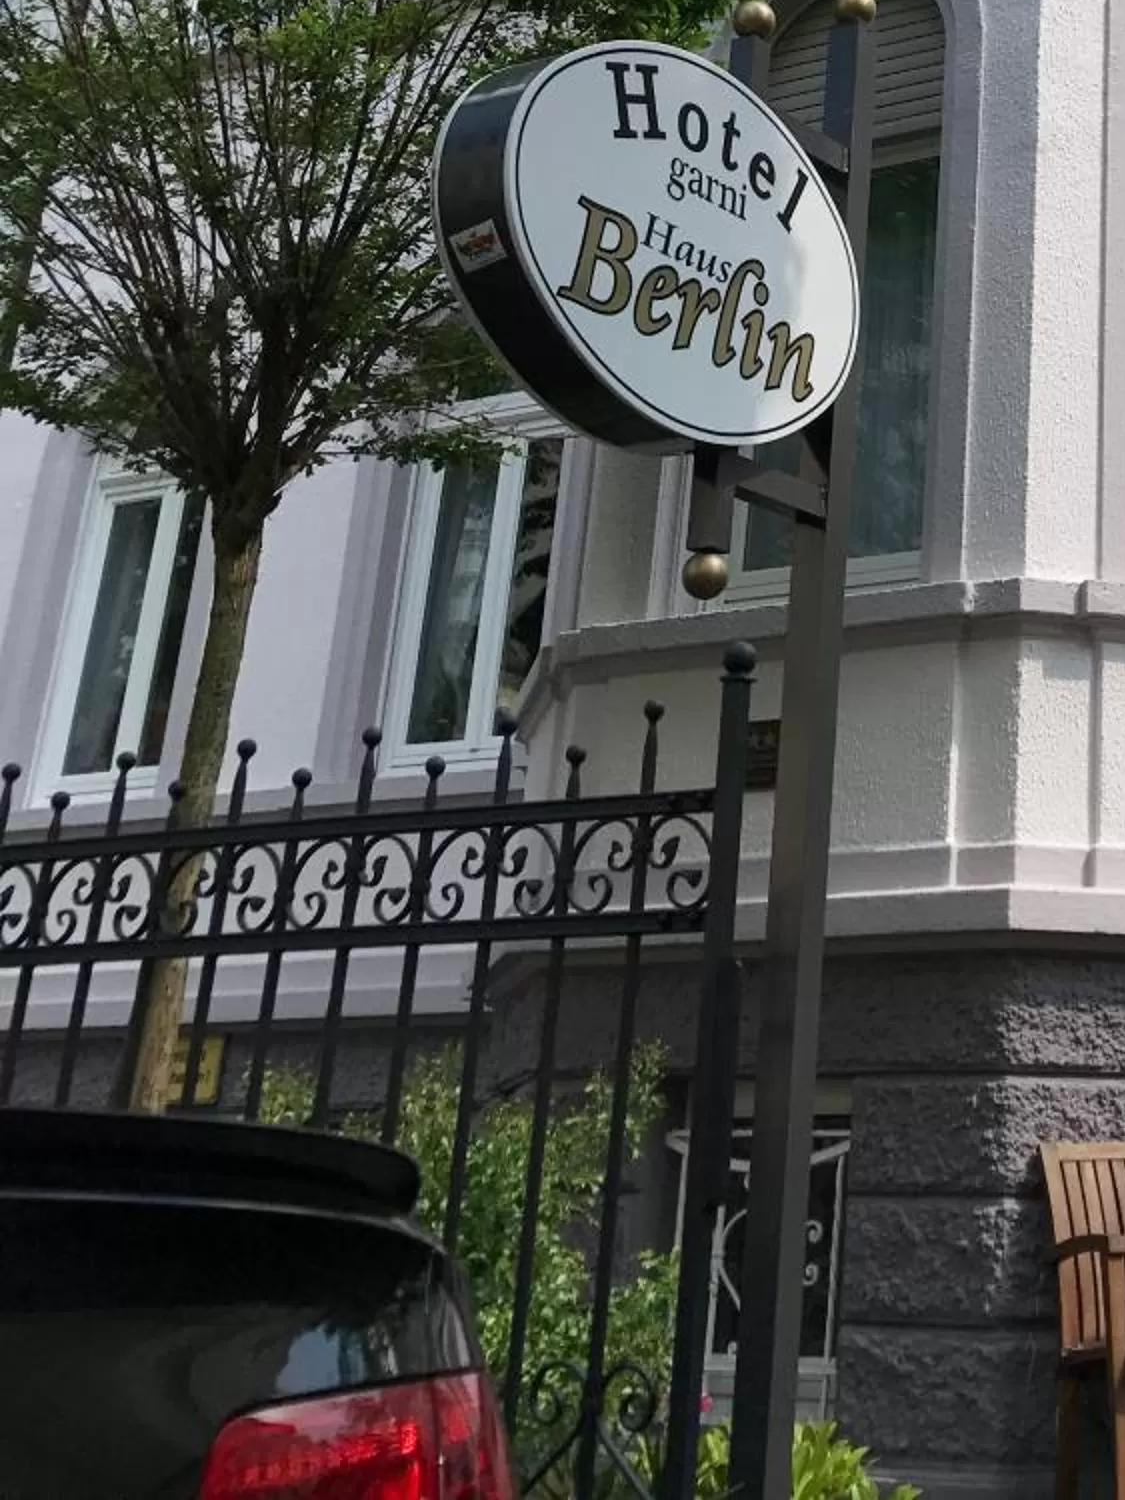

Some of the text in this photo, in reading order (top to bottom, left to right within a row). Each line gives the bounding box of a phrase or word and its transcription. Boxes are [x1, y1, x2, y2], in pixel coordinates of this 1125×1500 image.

[606, 62, 809, 233] Hotel
[667, 156, 748, 221] garni
[556, 195, 816, 403] Berlin
[641, 212, 735, 284] Haus
